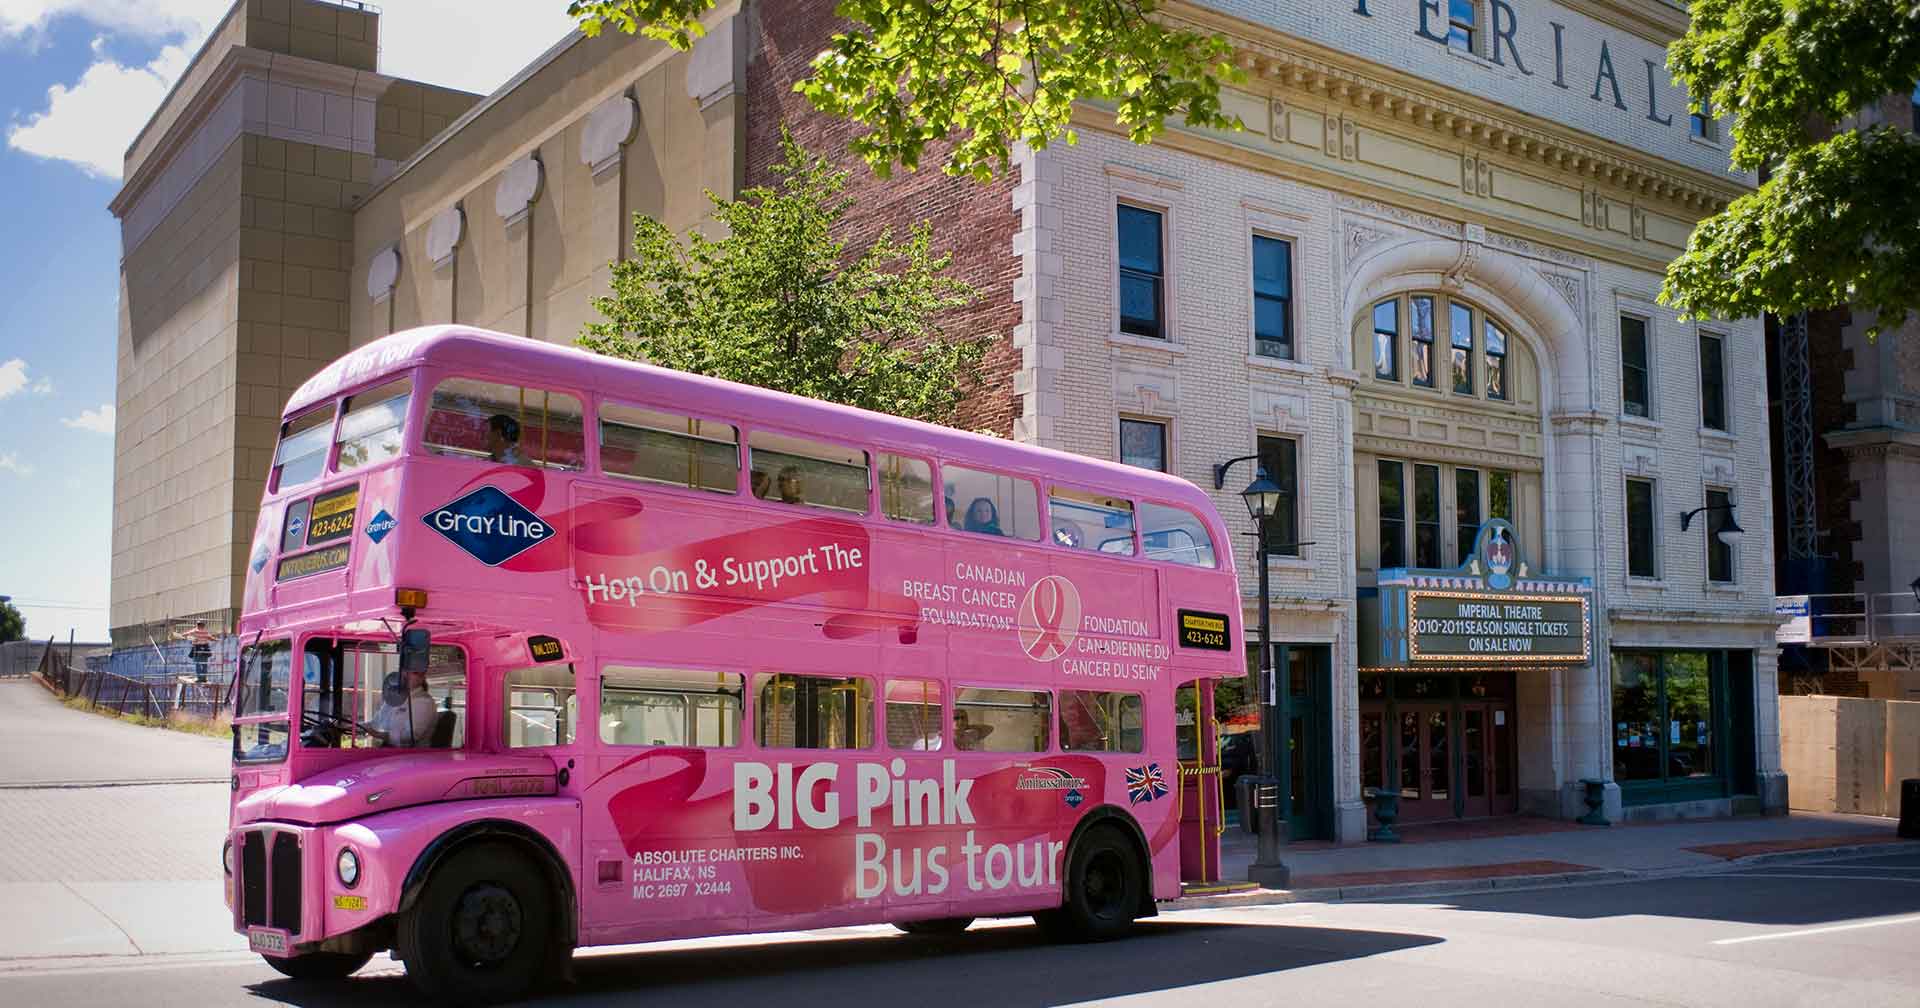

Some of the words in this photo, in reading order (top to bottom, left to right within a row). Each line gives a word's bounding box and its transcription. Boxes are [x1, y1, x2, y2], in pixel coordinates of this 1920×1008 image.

[1352, 0, 1672, 126] ERIAL
[312, 513, 353, 537] 423-6242
[367, 522, 382, 533] Gray
[382, 520, 395, 529] Line
[435, 511, 493, 534] Gray
[499, 514, 544, 539] Line
[586, 573, 644, 608] Hop
[650, 566, 688, 594] On
[695, 559, 719, 589] &
[723, 548, 818, 590] Support
[820, 543, 863, 571] The
[956, 562, 1025, 587] CANADIAN
[903, 580, 958, 601] BREAST
[962, 588, 1016, 609] CANCER
[1458, 604, 1501, 618] IMPERIAL
[1504, 605, 1542, 620] THEATRE
[1084, 615, 1148, 636] FONDATION
[1465, 621, 1502, 635] SEASON
[1503, 622, 1533, 635] SINGLE
[1534, 622, 1568, 636] TICKETS
[1186, 631, 1224, 646] 423-6242
[1469, 638, 1484, 651] ON
[1484, 638, 1508, 651] SALE
[1508, 639, 1532, 652] NOW
[1078, 638, 1152, 658] CANADIENNE
[1154, 643, 1170, 661] DU
[1062, 659, 1110, 678] CANCER
[1114, 662, 1129, 679] DU
[733, 762, 839, 832] BIG
[857, 757, 976, 827] Pink
[634, 849, 706, 865] ABSOLUTE
[709, 847, 778, 863] CHARTERS
[780, 846, 804, 860] INC.
[856, 833, 951, 900] Bus
[961, 830, 1064, 893] tour
[633, 867, 695, 882] HALIFAX,
[698, 866, 716, 879] NS
[633, 885, 656, 899] MC
[658, 884, 688, 898] 2697
[695, 881, 731, 896] X2444
